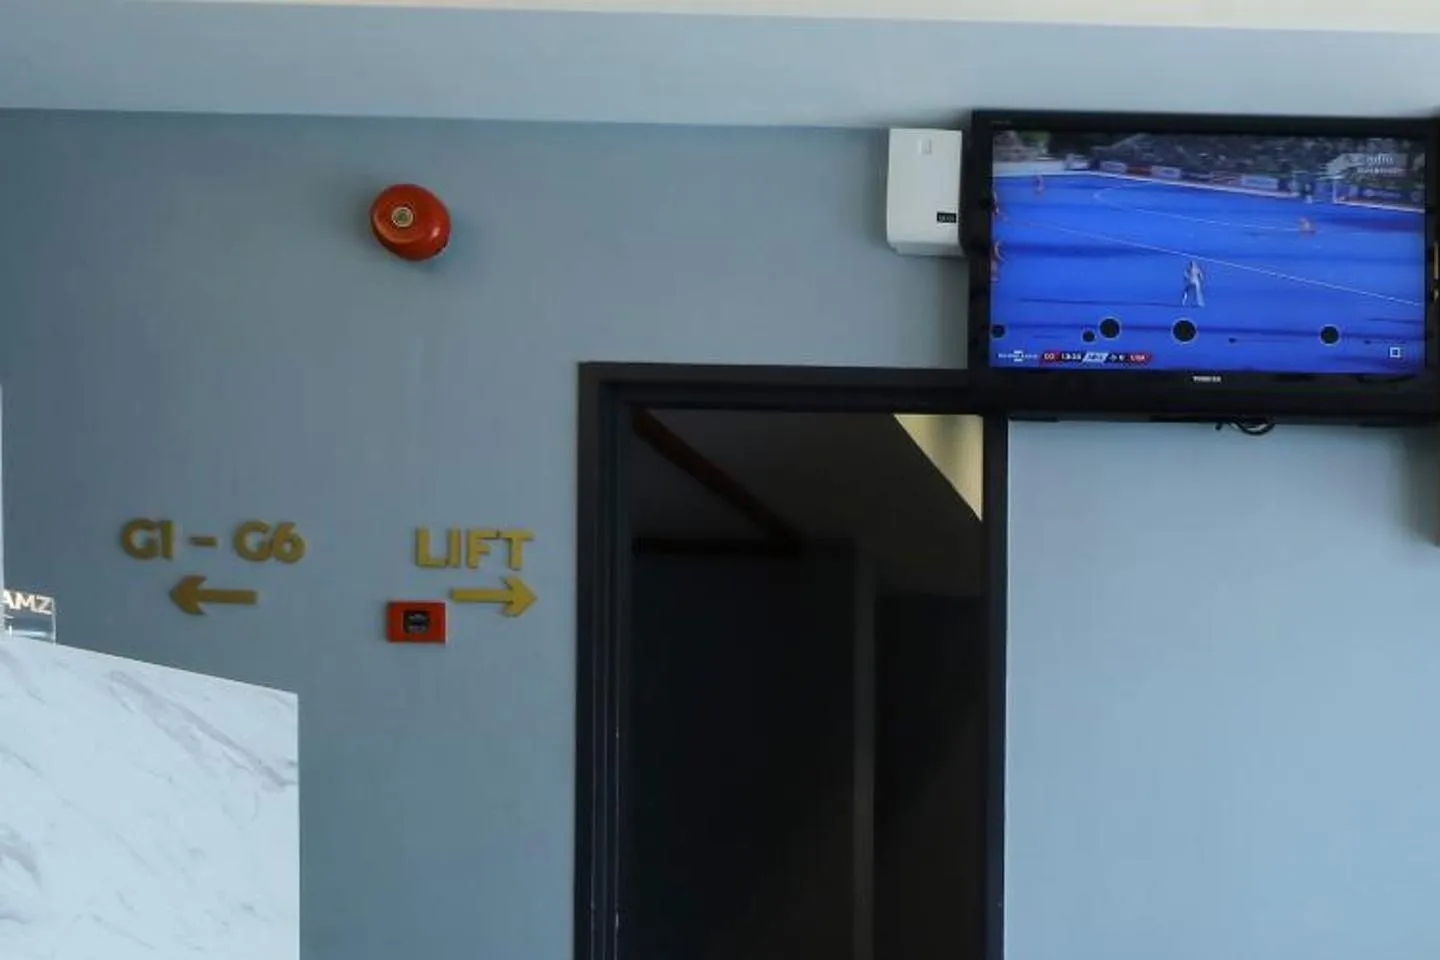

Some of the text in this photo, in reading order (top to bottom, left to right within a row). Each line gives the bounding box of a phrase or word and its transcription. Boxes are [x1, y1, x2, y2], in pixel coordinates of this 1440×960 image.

[120, 517, 175, 561] G1
[233, 520, 307, 564] G6
[414, 527, 536, 571] LIFT
